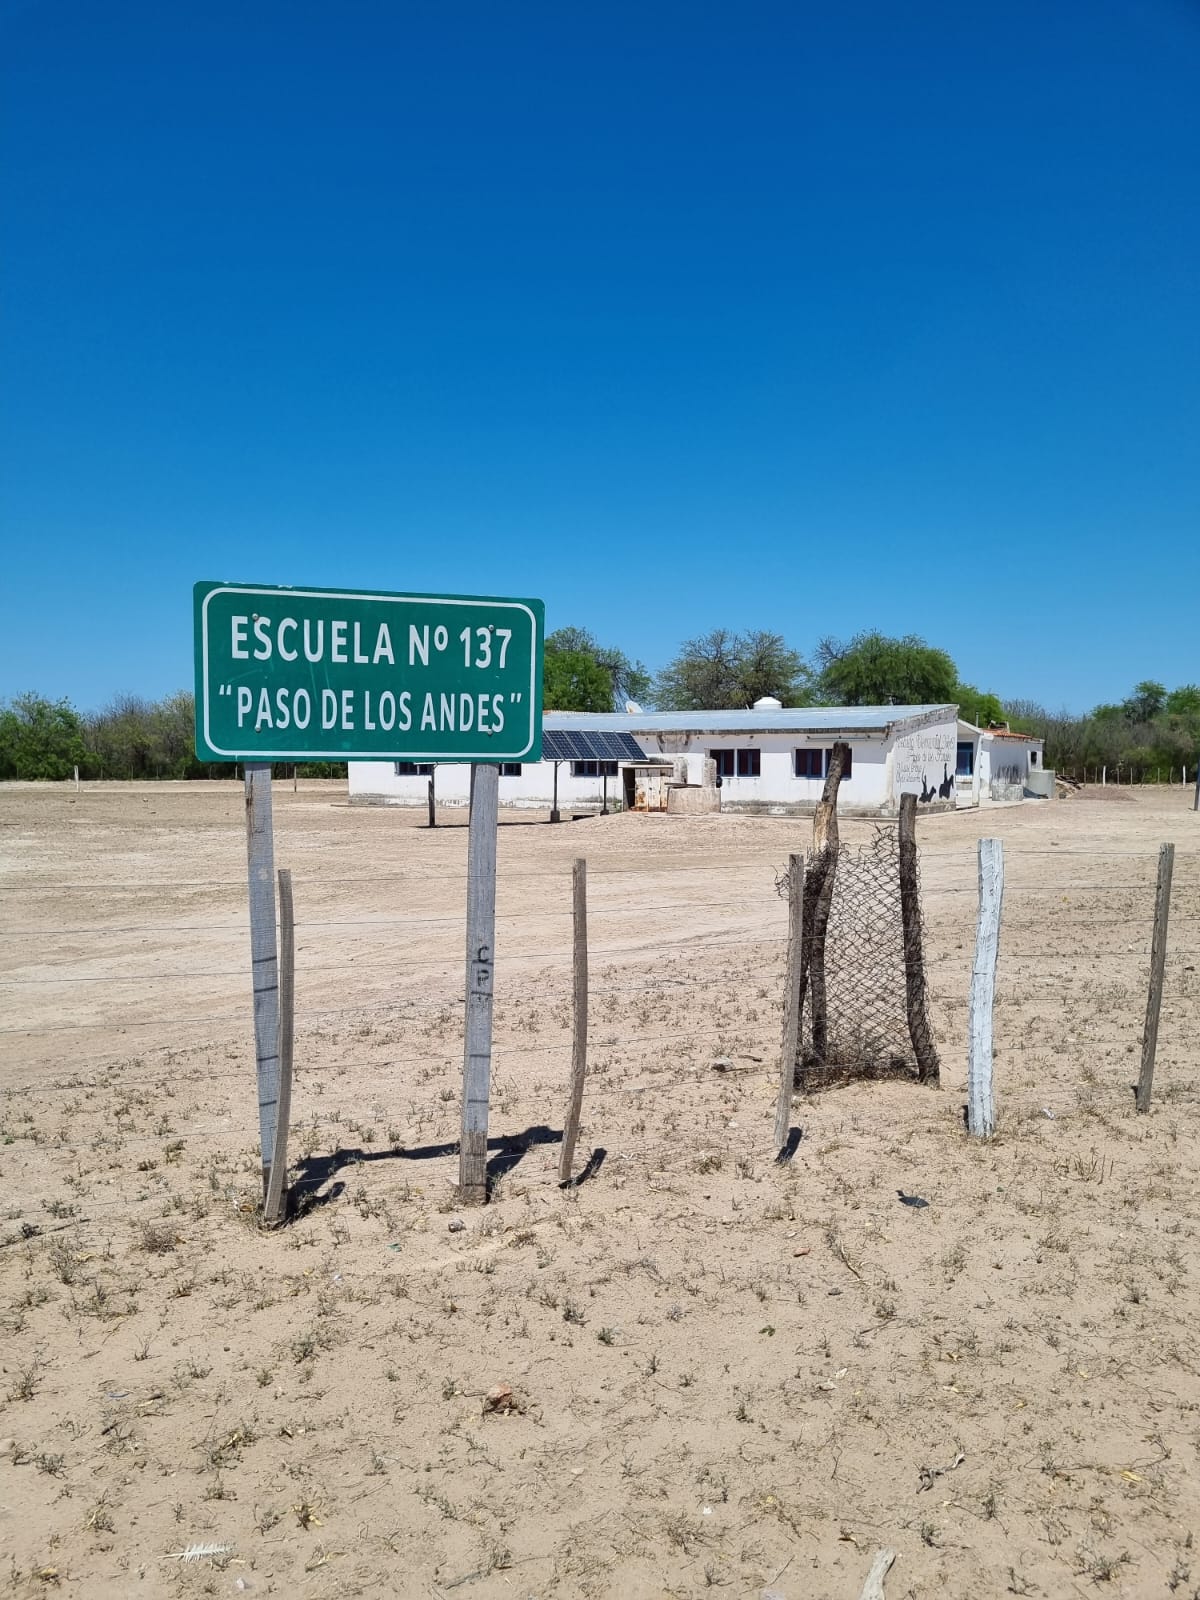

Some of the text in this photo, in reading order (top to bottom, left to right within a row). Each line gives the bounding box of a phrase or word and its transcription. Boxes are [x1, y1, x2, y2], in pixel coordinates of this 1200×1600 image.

[231, 615, 395, 665] ESCUELA
[459, 626, 512, 669] 137
[321, 688, 354, 730] DE
[364, 690, 412, 731] LOS
